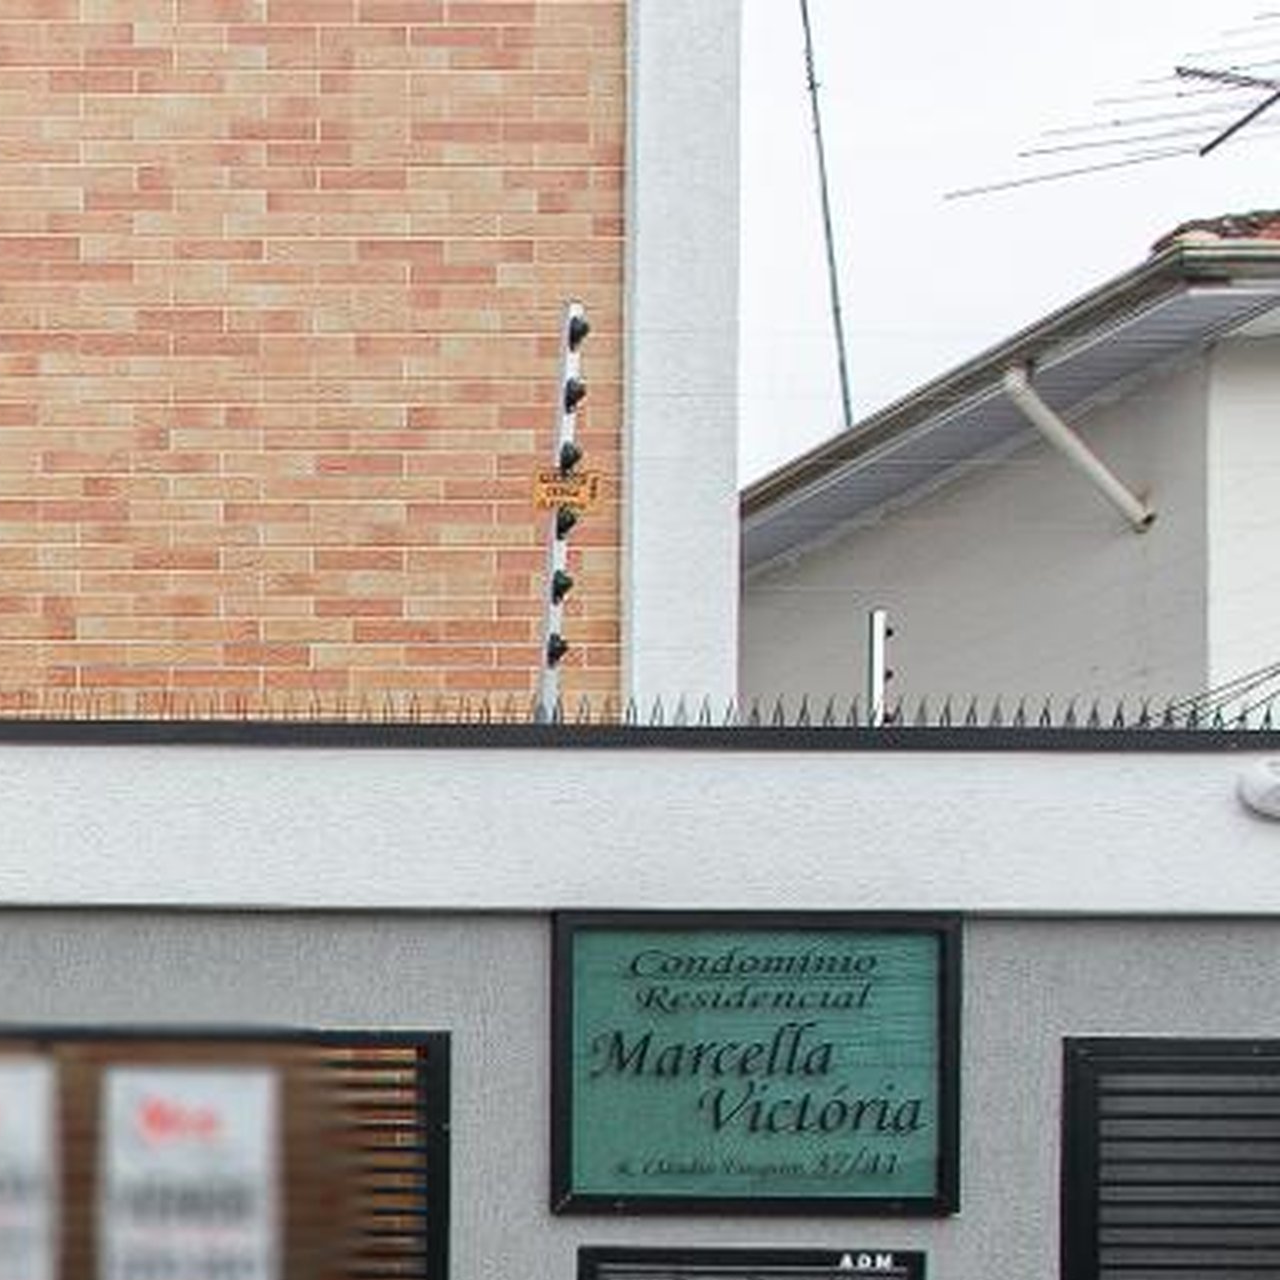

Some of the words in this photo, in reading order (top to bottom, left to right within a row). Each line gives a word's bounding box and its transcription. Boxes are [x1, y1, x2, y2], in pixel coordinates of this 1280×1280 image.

[636, 980, 872, 1013] Residencial
[590, 1022, 834, 1079] Marcella
[699, 1083, 928, 1135] Victória
